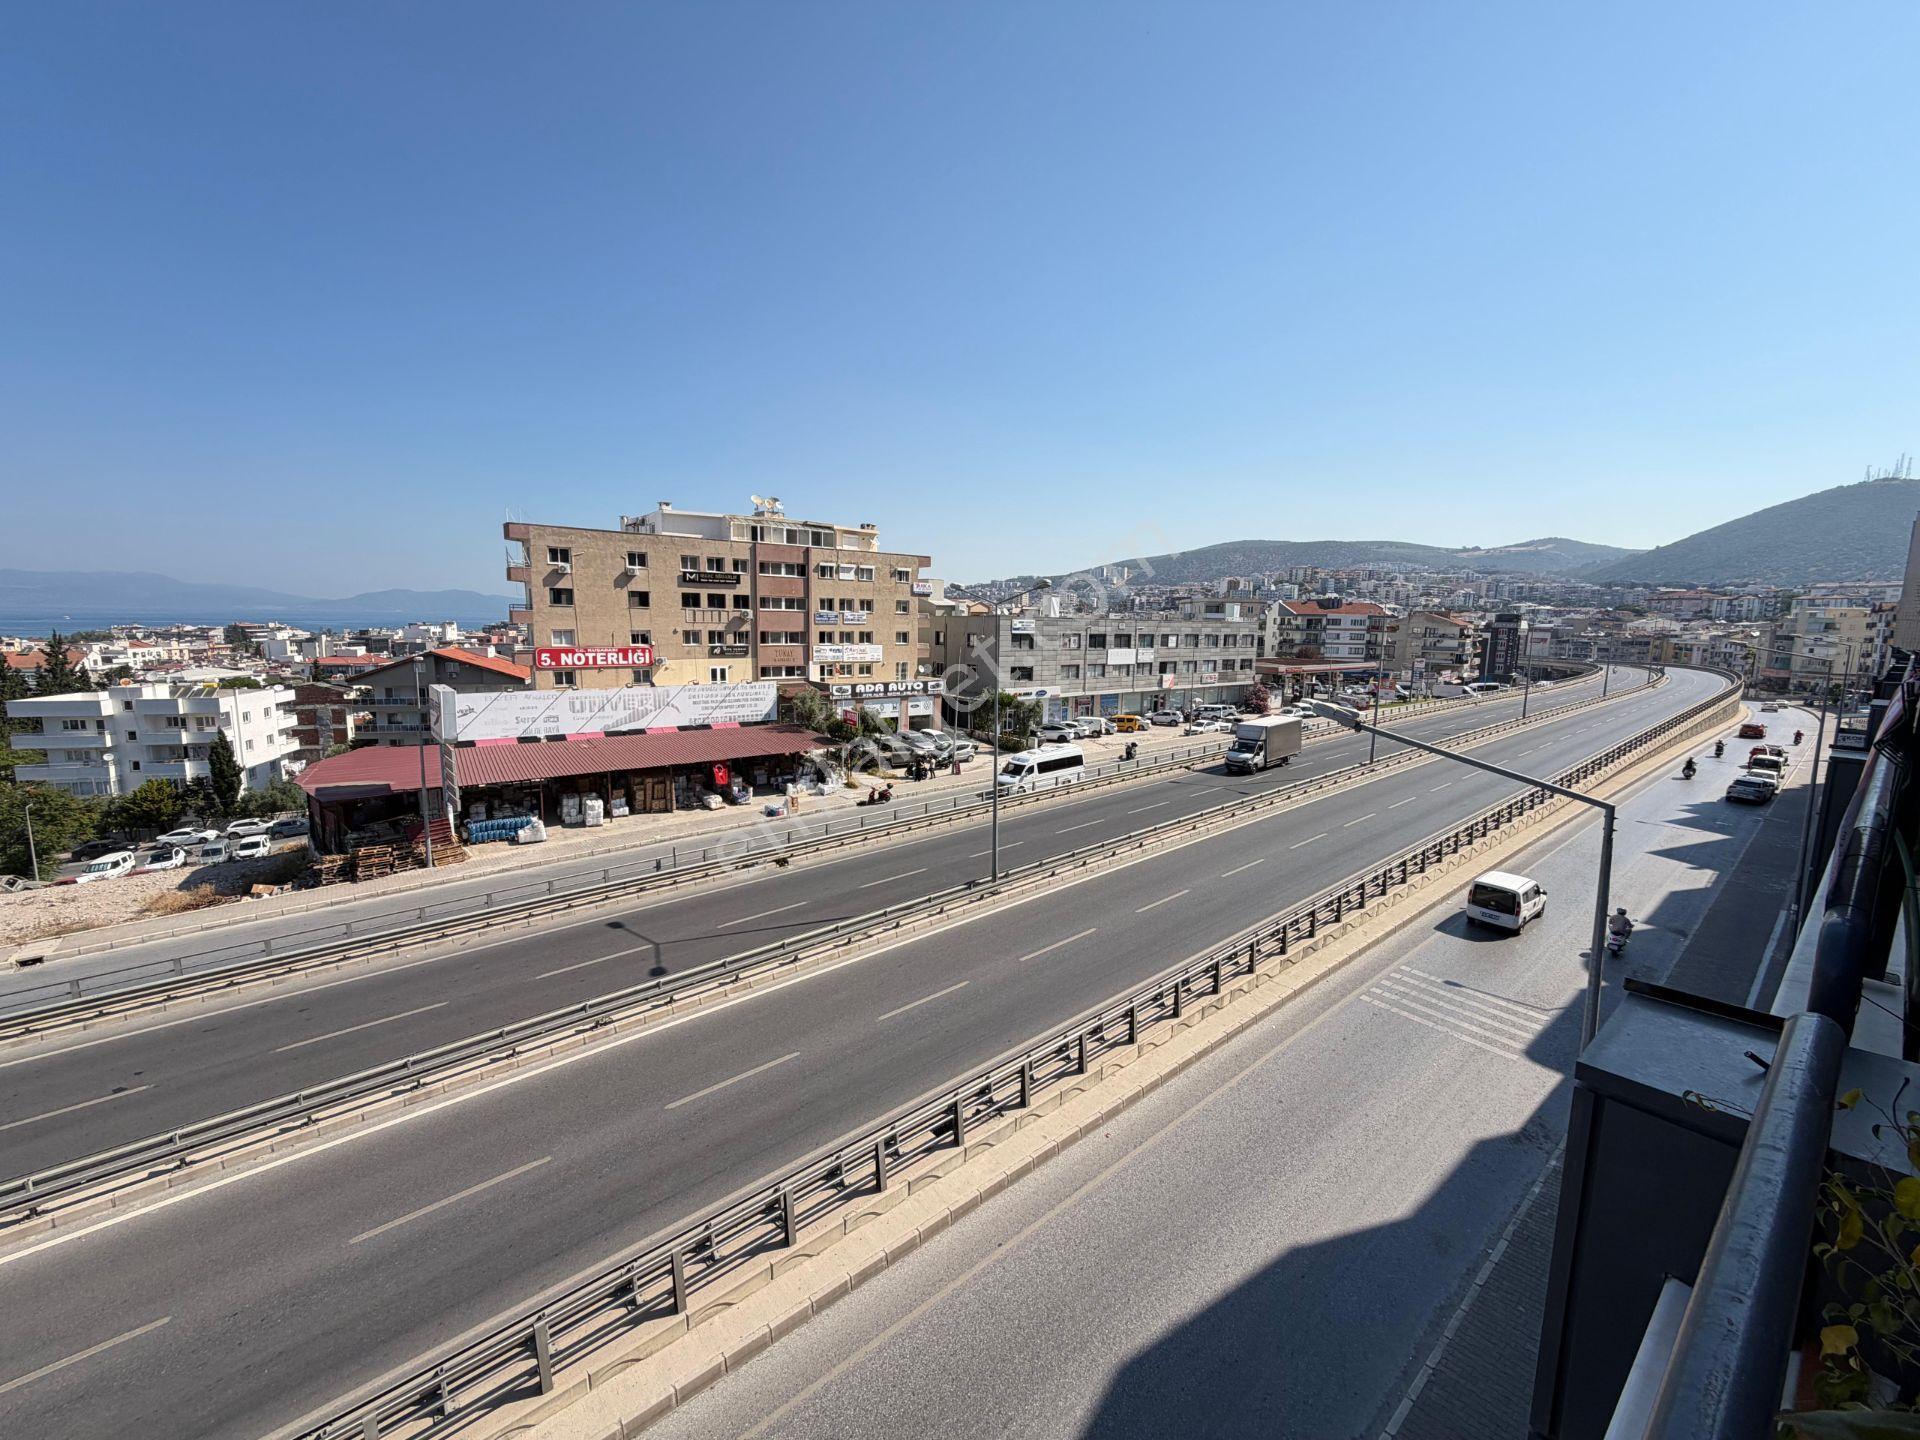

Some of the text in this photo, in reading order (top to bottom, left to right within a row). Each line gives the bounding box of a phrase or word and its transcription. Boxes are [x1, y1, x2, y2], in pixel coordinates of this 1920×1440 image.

[541, 649, 650, 666] 5. NOTERLİĞİ
[855, 681, 924, 693] ADA AUTO
